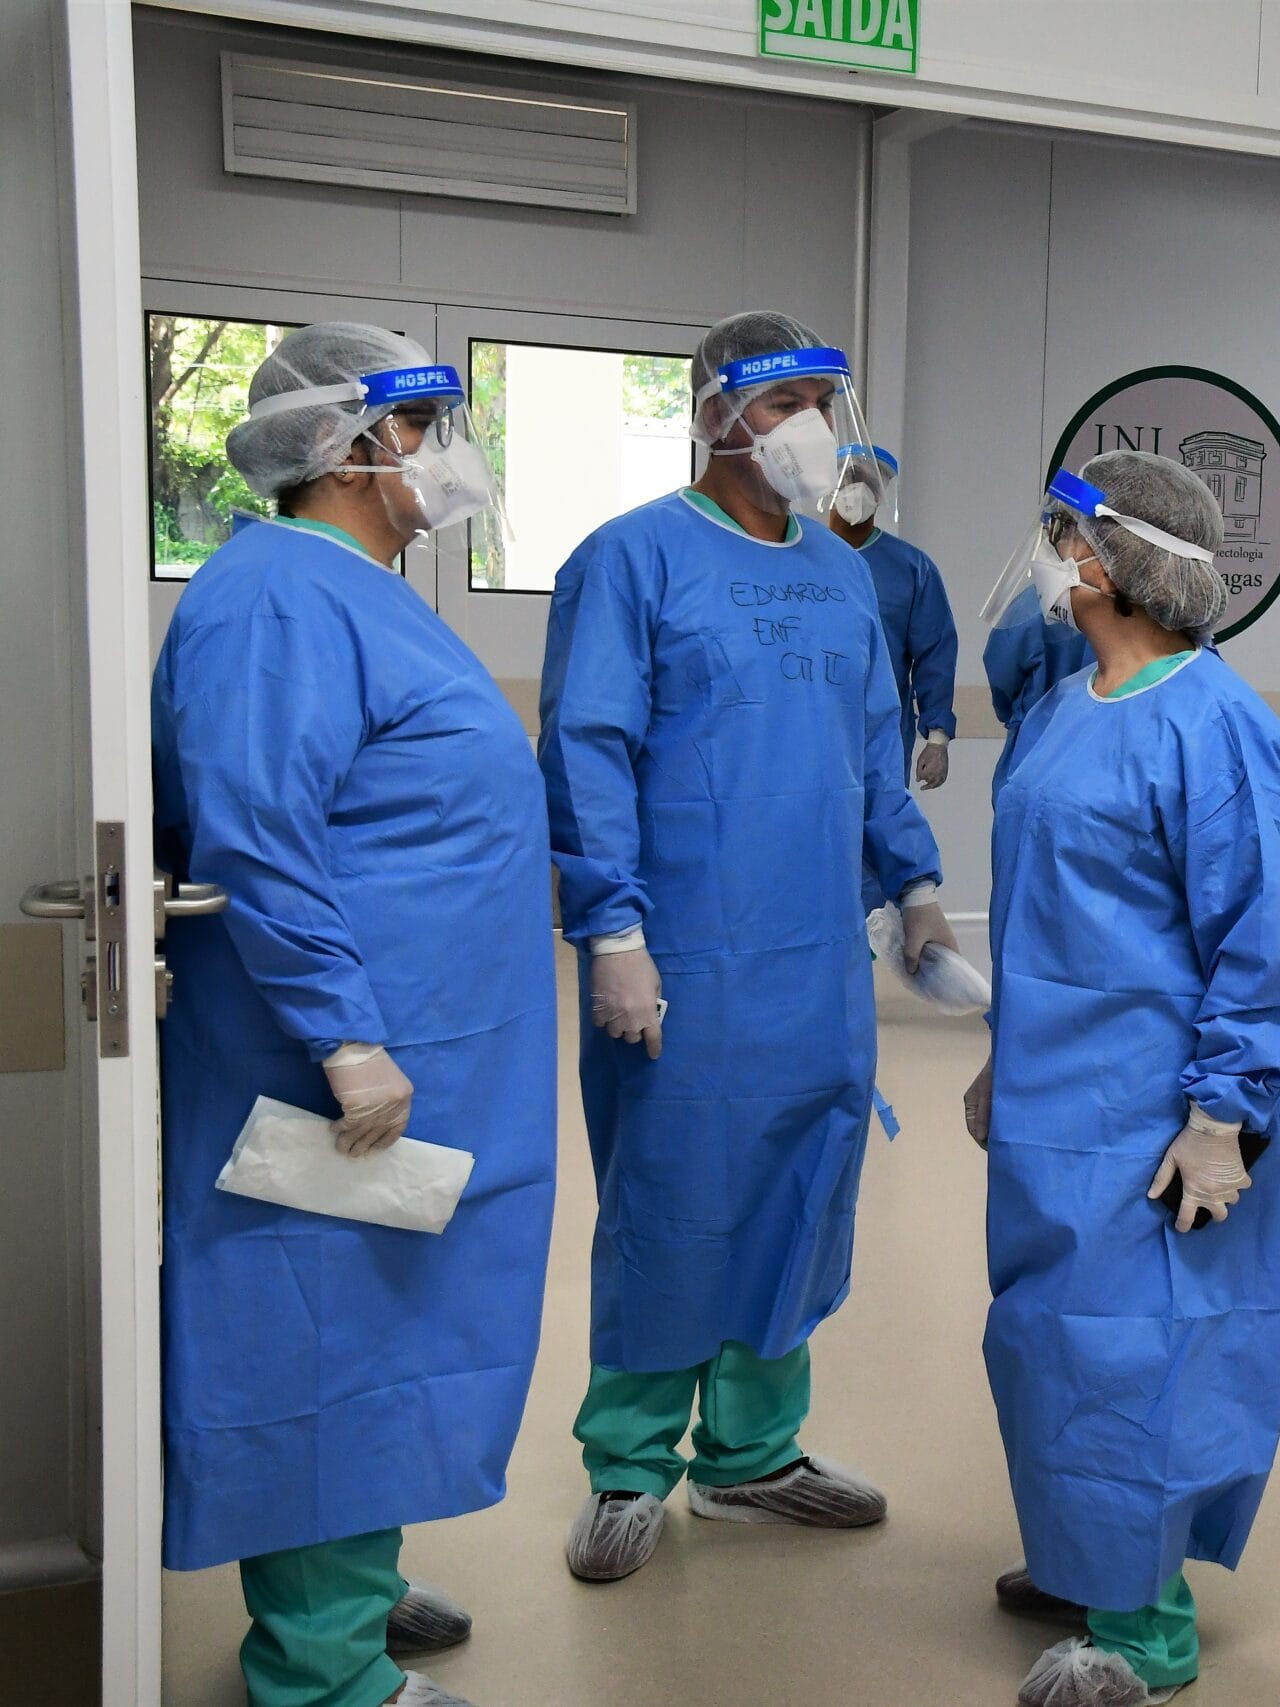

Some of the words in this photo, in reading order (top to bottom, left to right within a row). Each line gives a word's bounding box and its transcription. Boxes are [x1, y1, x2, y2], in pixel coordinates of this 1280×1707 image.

[742, 354, 799, 376] HOSPEL
[394, 371, 449, 389] HOSPEL
[1094, 424, 1163, 456] INI
[729, 582, 847, 607] EDUARDO
[1220, 573, 1263, 595] agas
